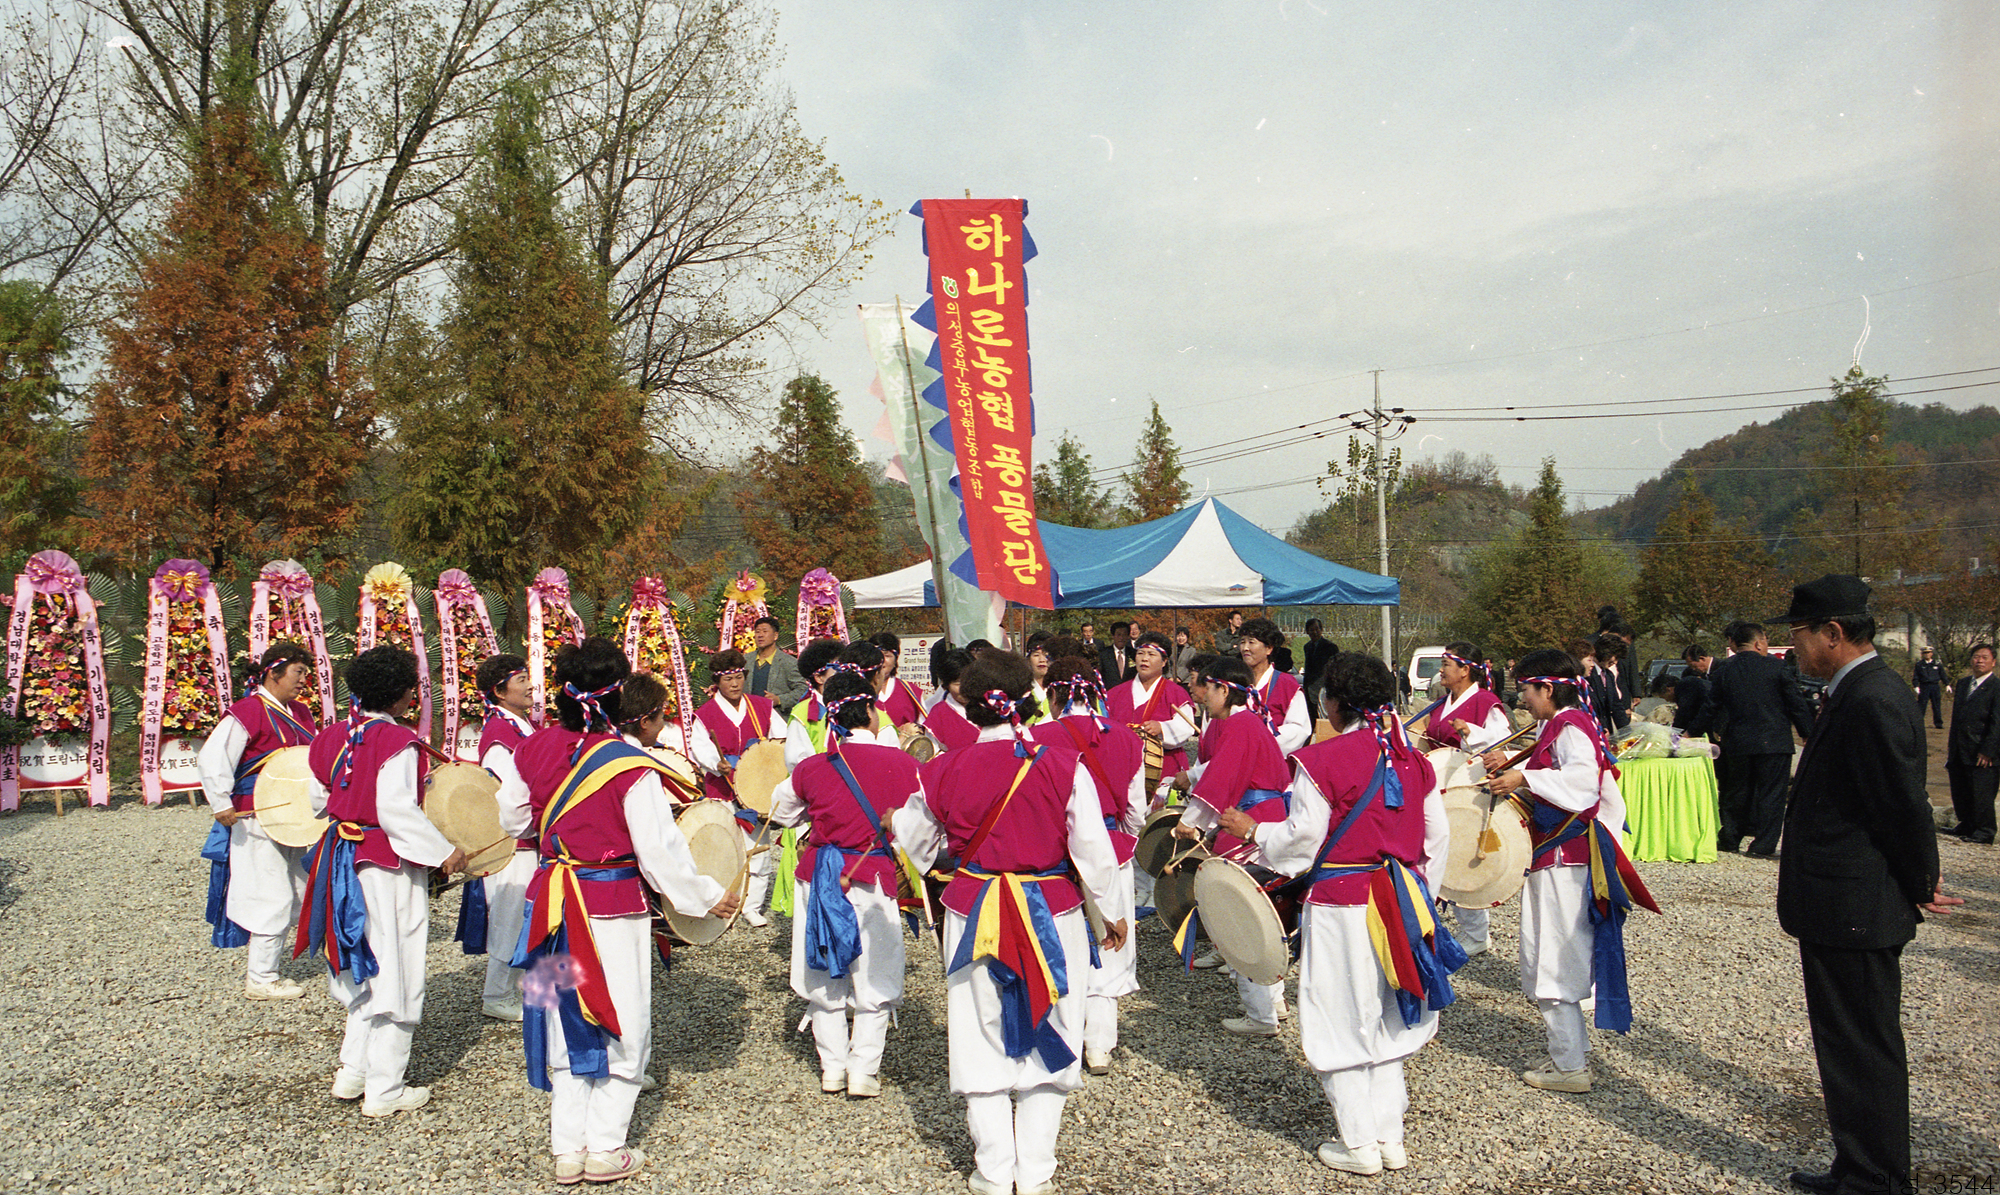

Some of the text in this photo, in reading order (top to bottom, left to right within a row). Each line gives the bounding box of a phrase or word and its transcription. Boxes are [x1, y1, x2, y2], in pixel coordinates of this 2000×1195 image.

[208, 615, 221, 631] 축
[253, 613, 266, 642] 포항시
[530, 614, 541, 659] 안동시
[8, 610, 26, 678] 경남대학교
[150, 636, 164, 667] 고등학교
[309, 610, 322, 638] 경축
[318, 654, 331, 698] 기념비
[85, 629, 107, 774] 축 기념탑 건립
[146, 700, 160, 724] 지도자
[446, 697, 457, 717] 회장
[19, 752, 88, 767] 祝賀 드립니다
